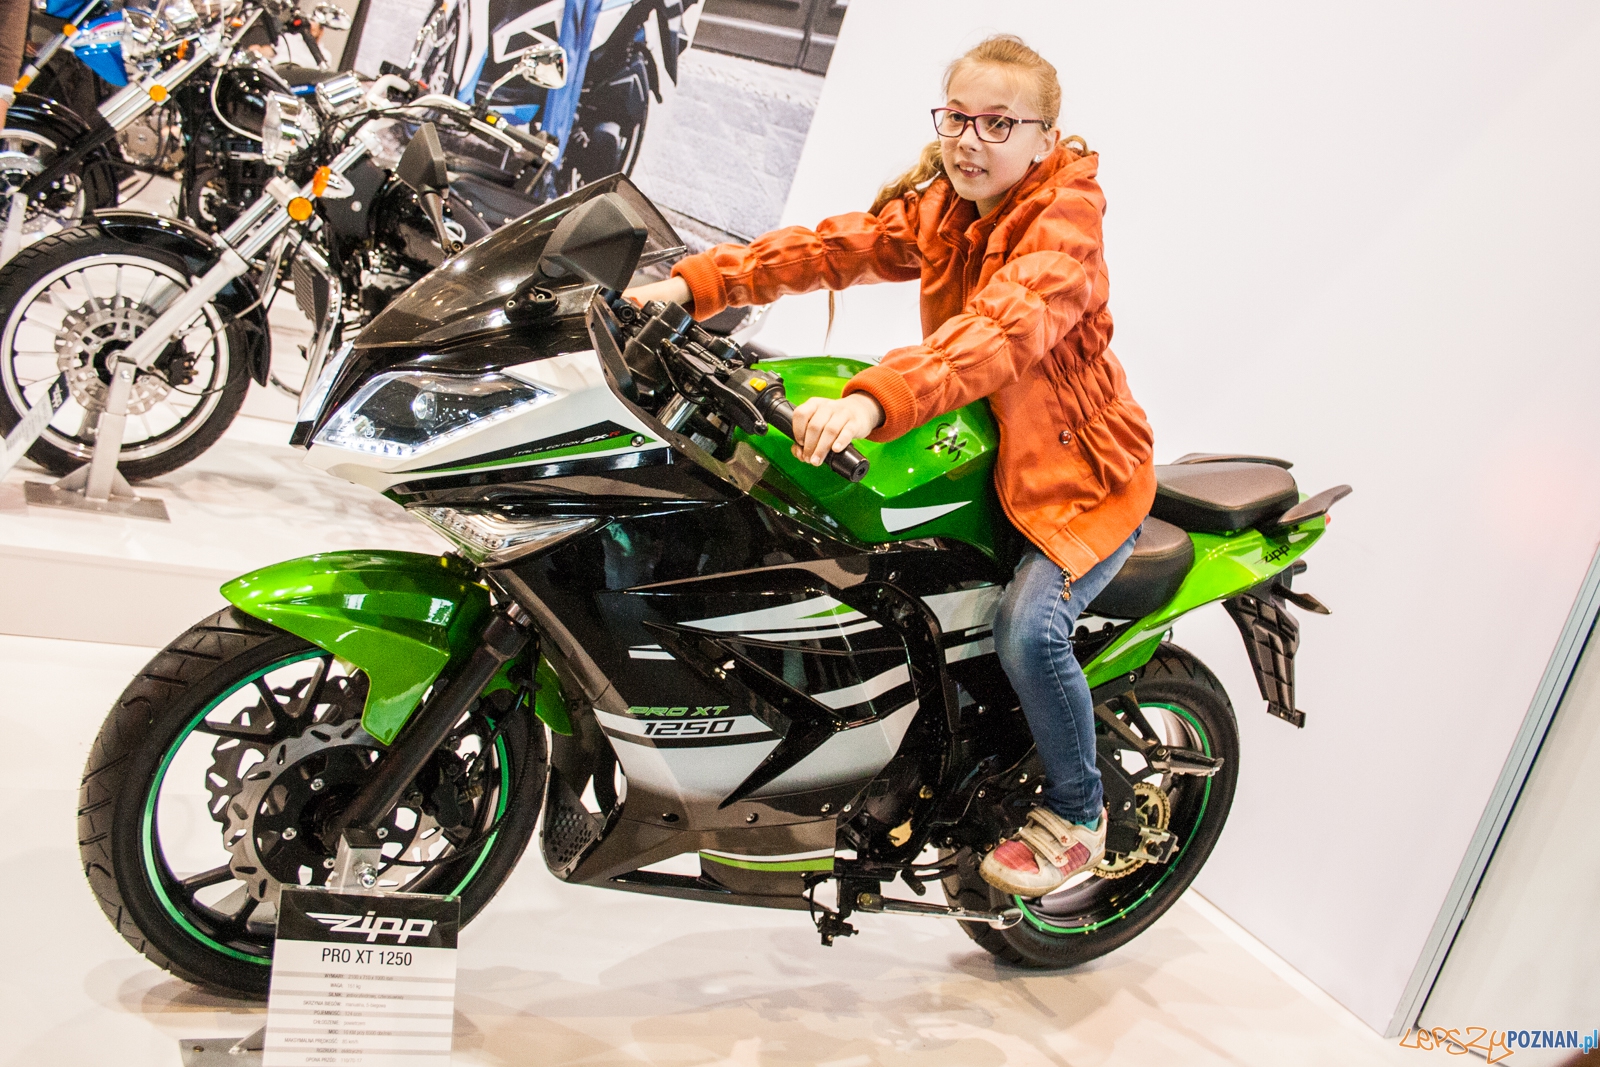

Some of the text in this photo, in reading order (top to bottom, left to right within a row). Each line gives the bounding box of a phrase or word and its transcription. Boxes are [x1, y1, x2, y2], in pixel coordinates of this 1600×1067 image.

[625, 705, 730, 717] PRO XT
[643, 719, 736, 736] 1250
[321, 947, 413, 967] PRO XT 1250
